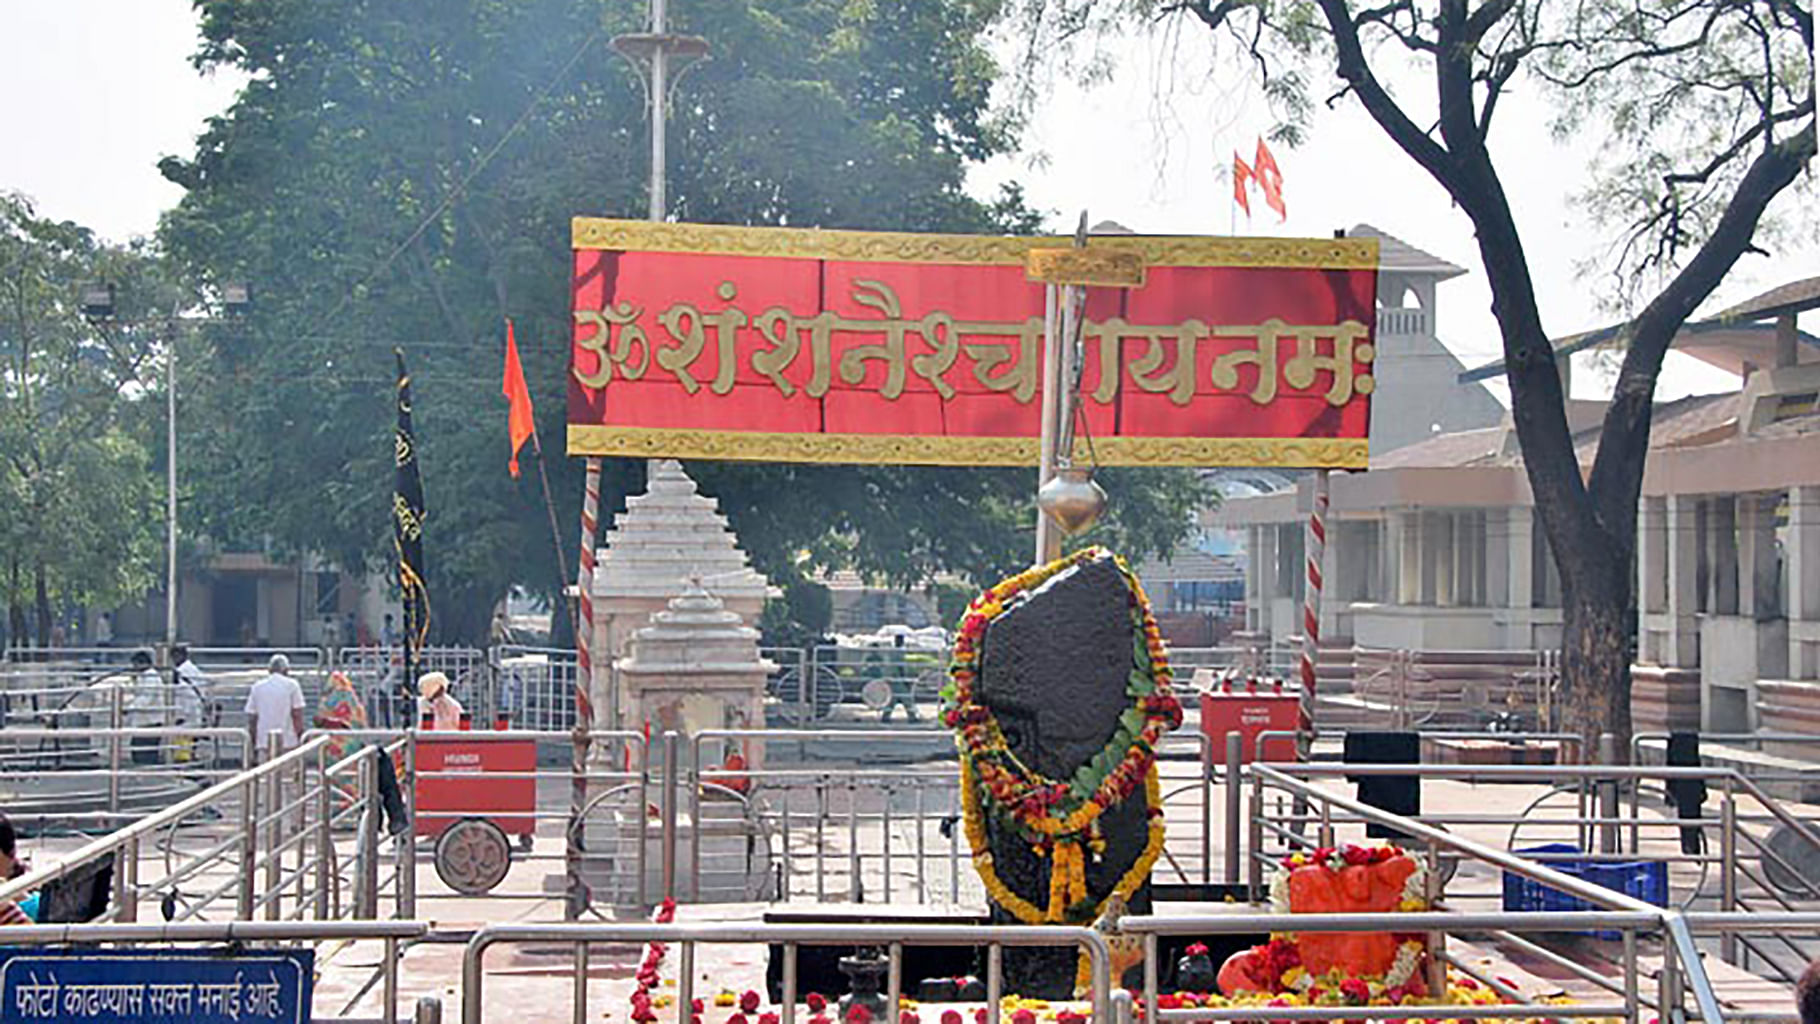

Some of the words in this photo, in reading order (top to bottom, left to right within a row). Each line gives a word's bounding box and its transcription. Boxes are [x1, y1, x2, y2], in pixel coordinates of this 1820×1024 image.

[573, 302, 651, 390] ॐ
[656, 280, 748, 396] शं
[751, 279, 1210, 406] शनैश्चाय
[15, 971, 60, 1017] फोटो
[64, 984, 145, 1017] काढण्यास
[149, 984, 194, 1016] सक्त
[198, 971, 243, 1021] मनाई
[246, 970, 285, 1017] आहे.
